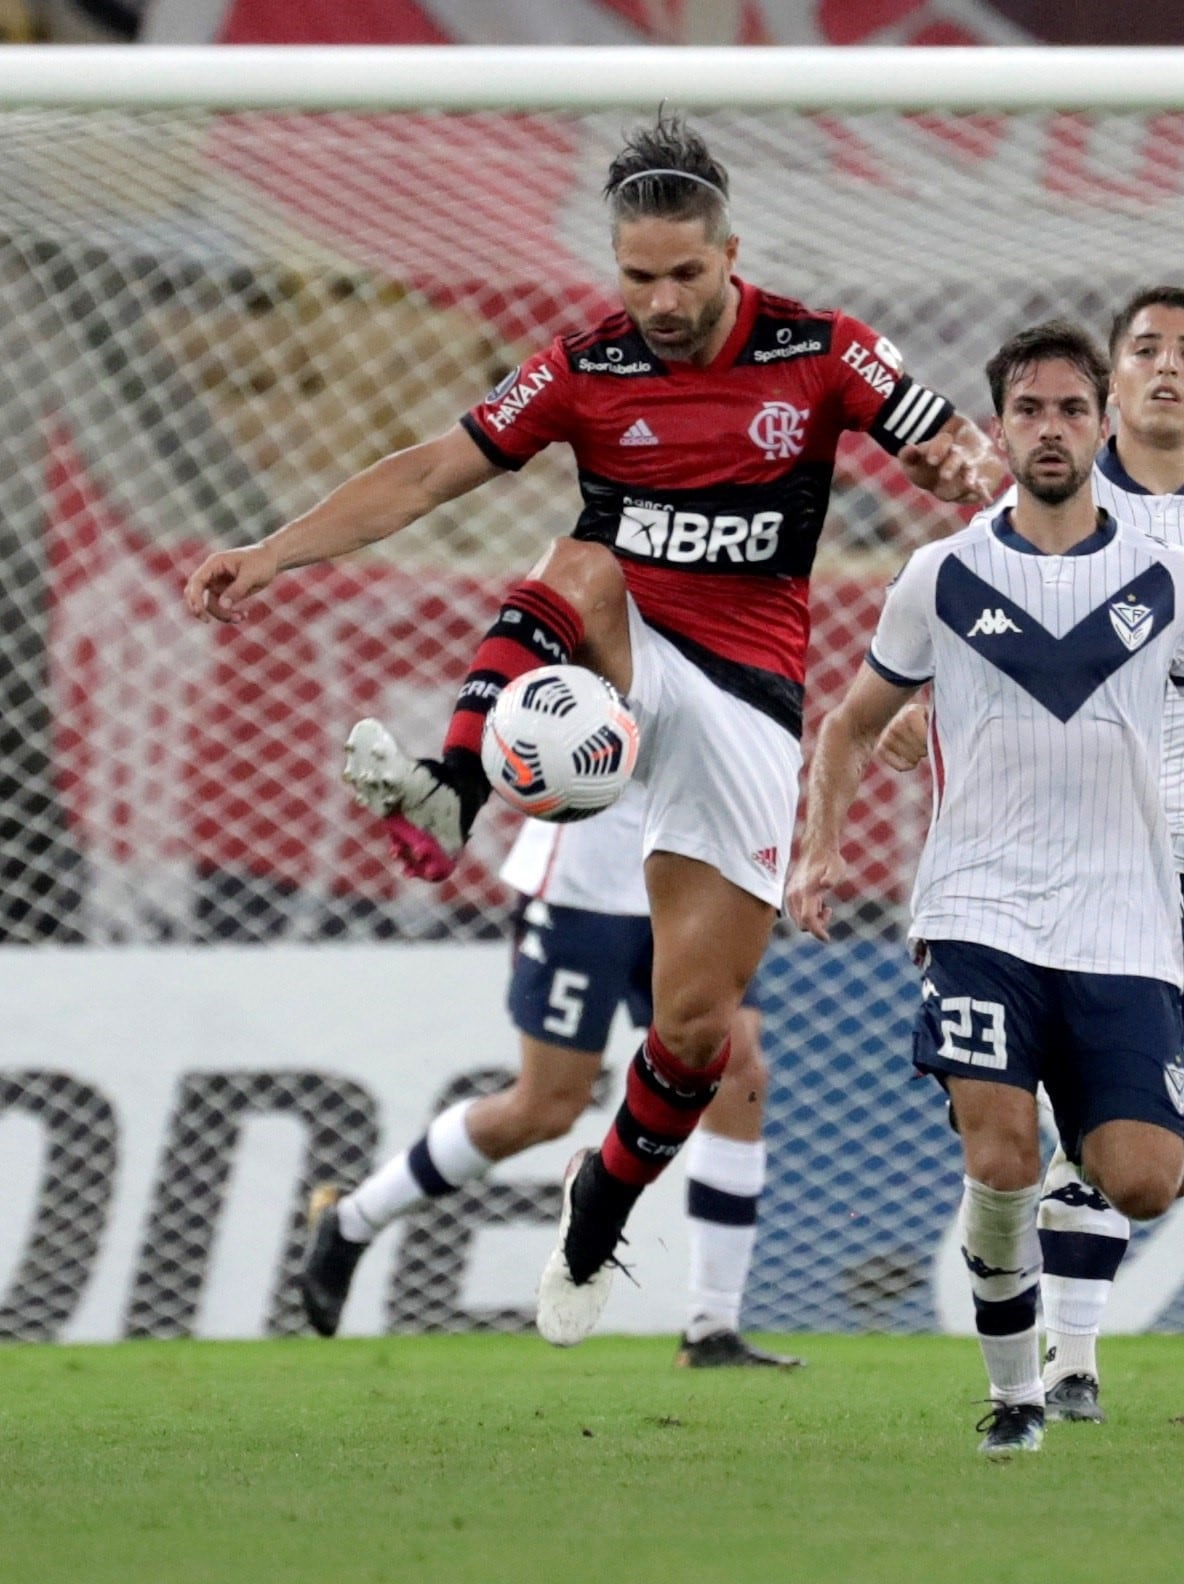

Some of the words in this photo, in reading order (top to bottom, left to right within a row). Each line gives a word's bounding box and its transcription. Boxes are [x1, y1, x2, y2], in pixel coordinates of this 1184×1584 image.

[488, 364, 554, 432] HAVAN
[841, 341, 896, 399] HAVA
[666, 511, 784, 563] BRB
[543, 970, 590, 1037] 5
[937, 997, 1008, 1070] 23
